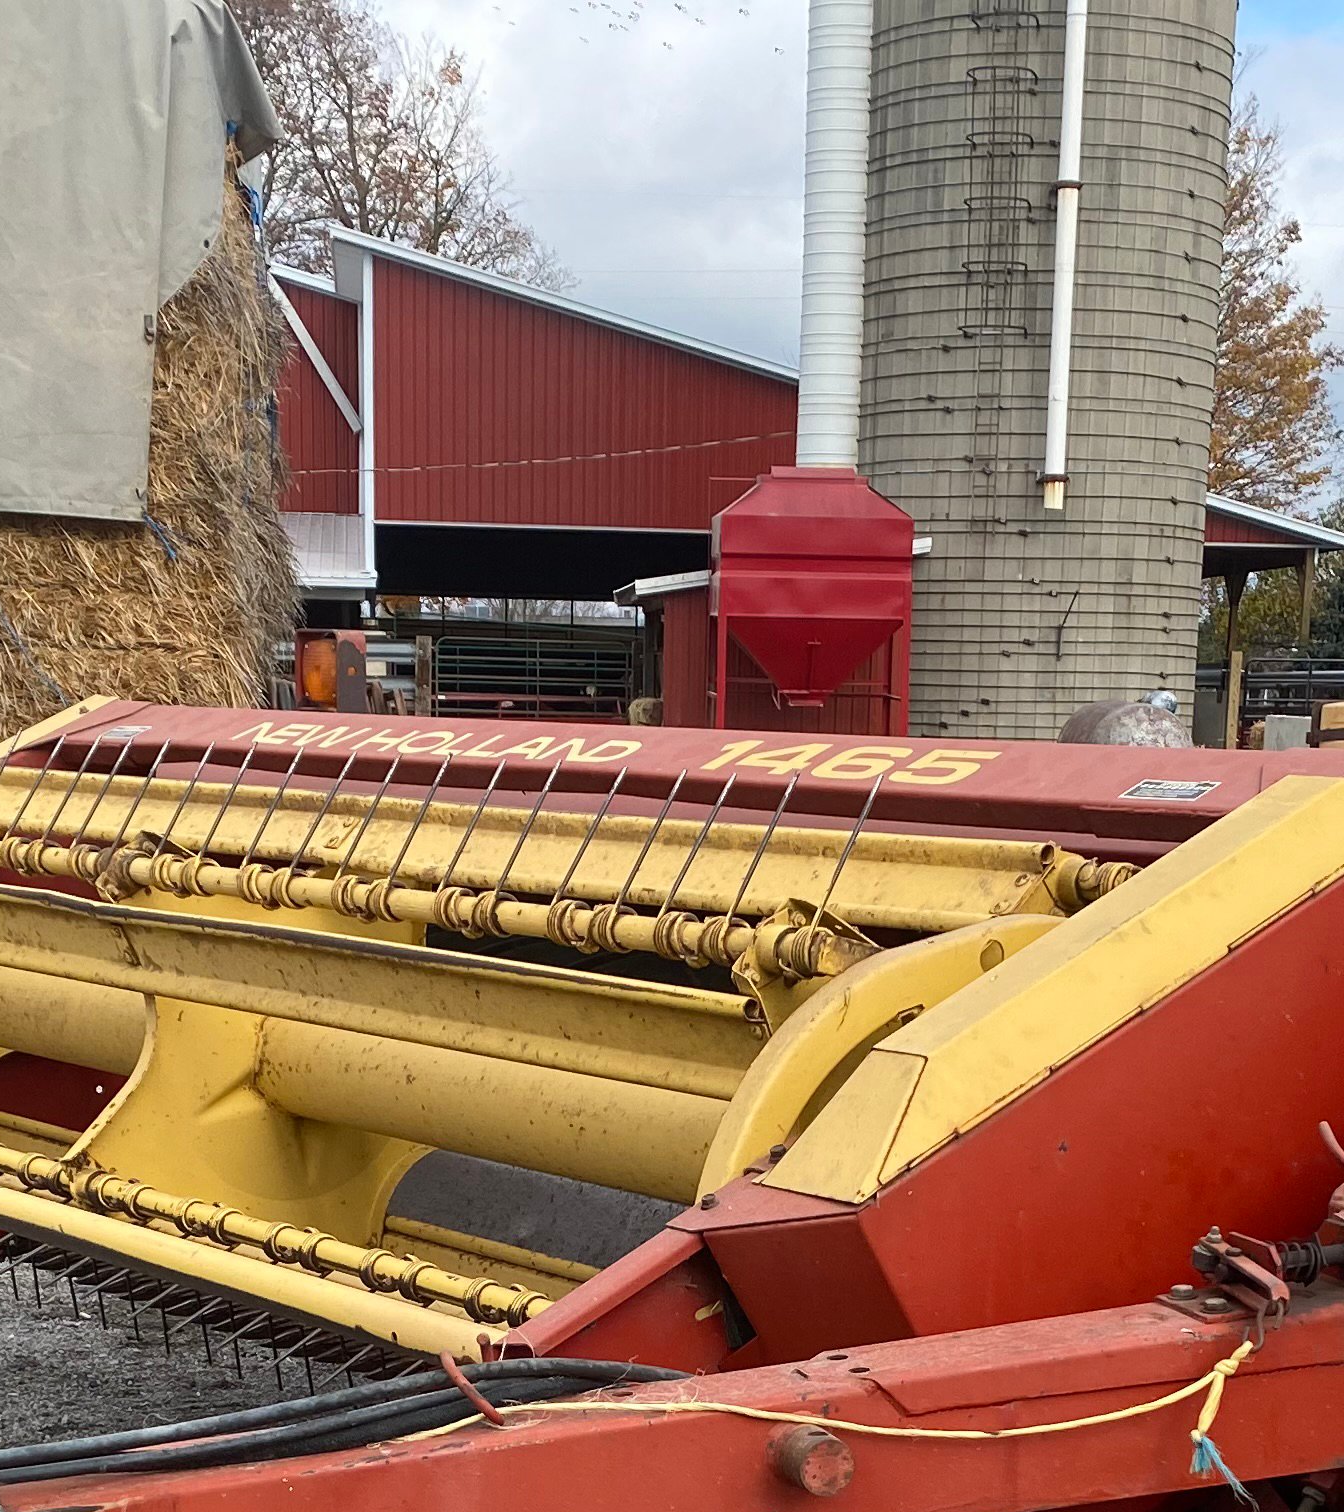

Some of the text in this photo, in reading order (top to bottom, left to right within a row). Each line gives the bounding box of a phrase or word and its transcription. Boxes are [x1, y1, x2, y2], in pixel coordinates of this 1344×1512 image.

[231, 721, 1003, 785] NEW HOLLAND 1465
